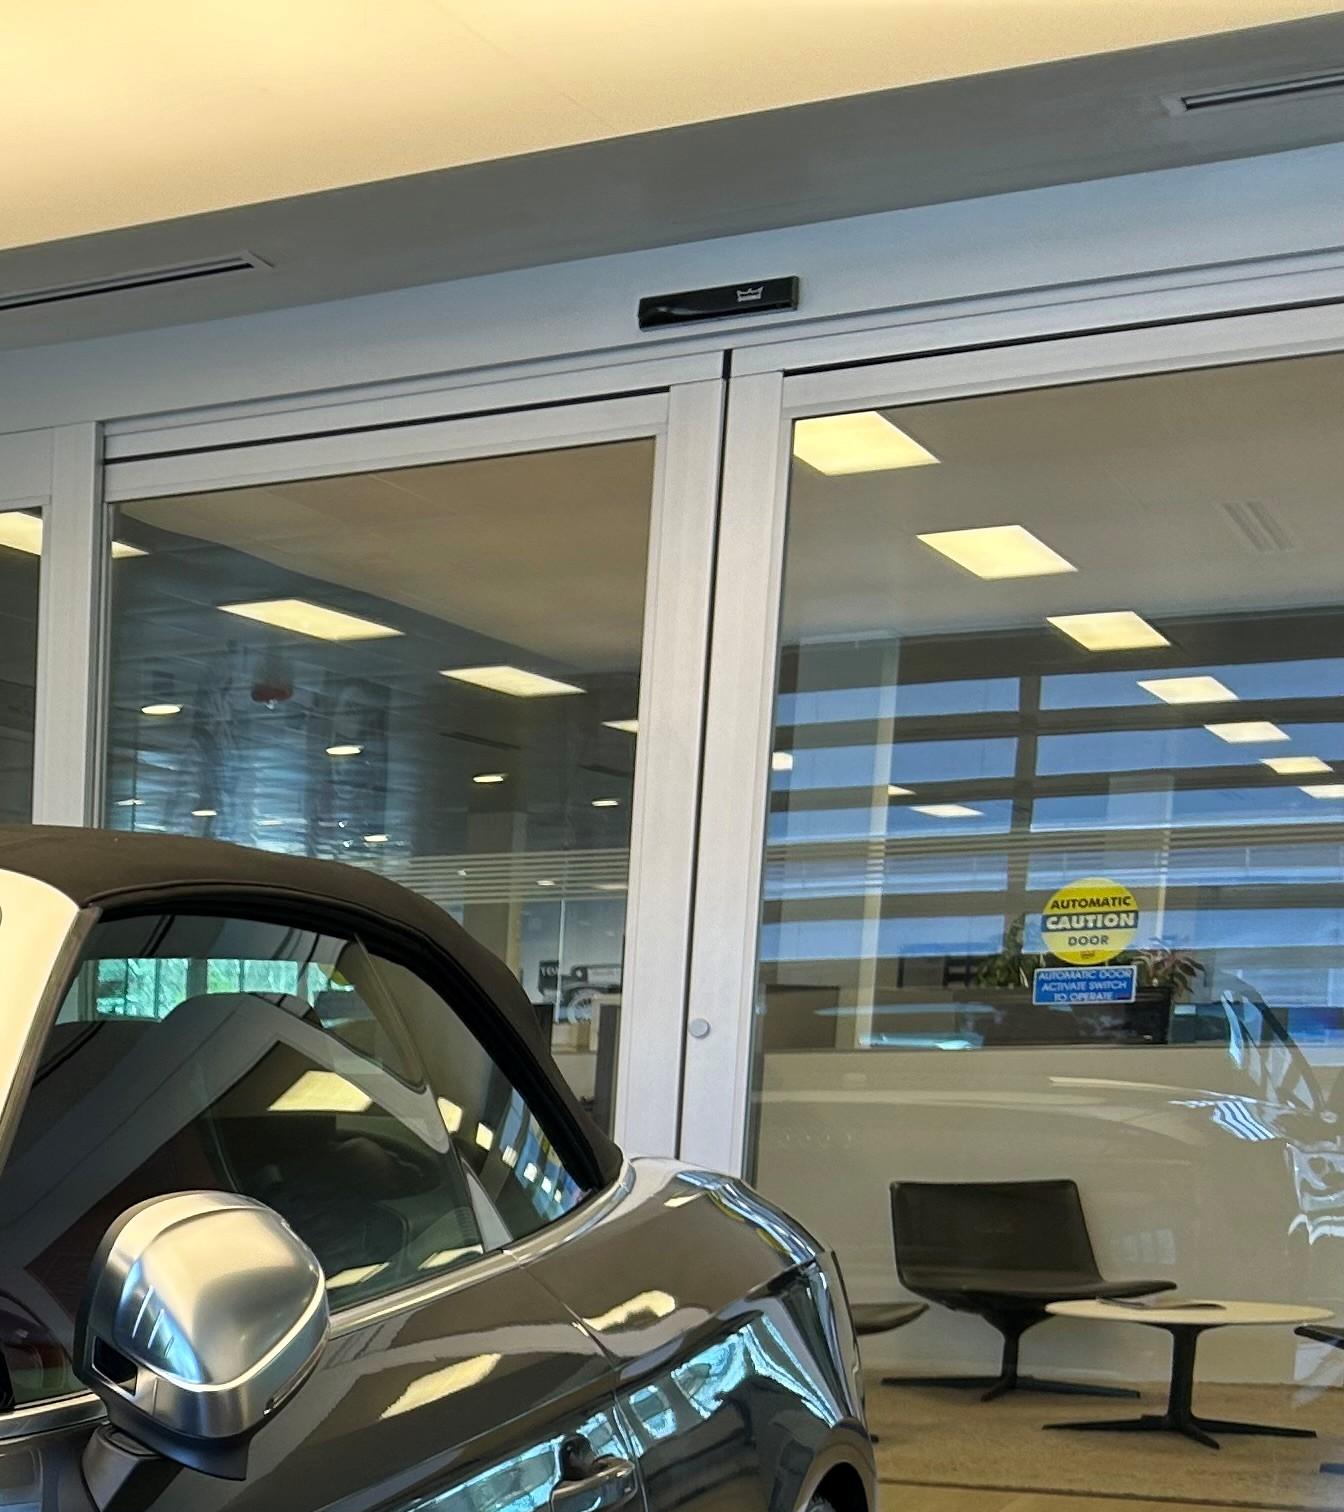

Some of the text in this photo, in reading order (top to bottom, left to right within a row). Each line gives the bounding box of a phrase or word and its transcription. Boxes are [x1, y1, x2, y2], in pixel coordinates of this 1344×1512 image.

[1051, 896, 1132, 910] AUTOMATIC
[1046, 913, 1135, 930] CAUTION
[1068, 935, 1109, 946] DOOR
[1039, 969, 1132, 981] AUTOMATIC DOOR
[1041, 979, 1128, 993] ACTIVATE SWITCH
[1053, 991, 1115, 1003] TO OPERATE
